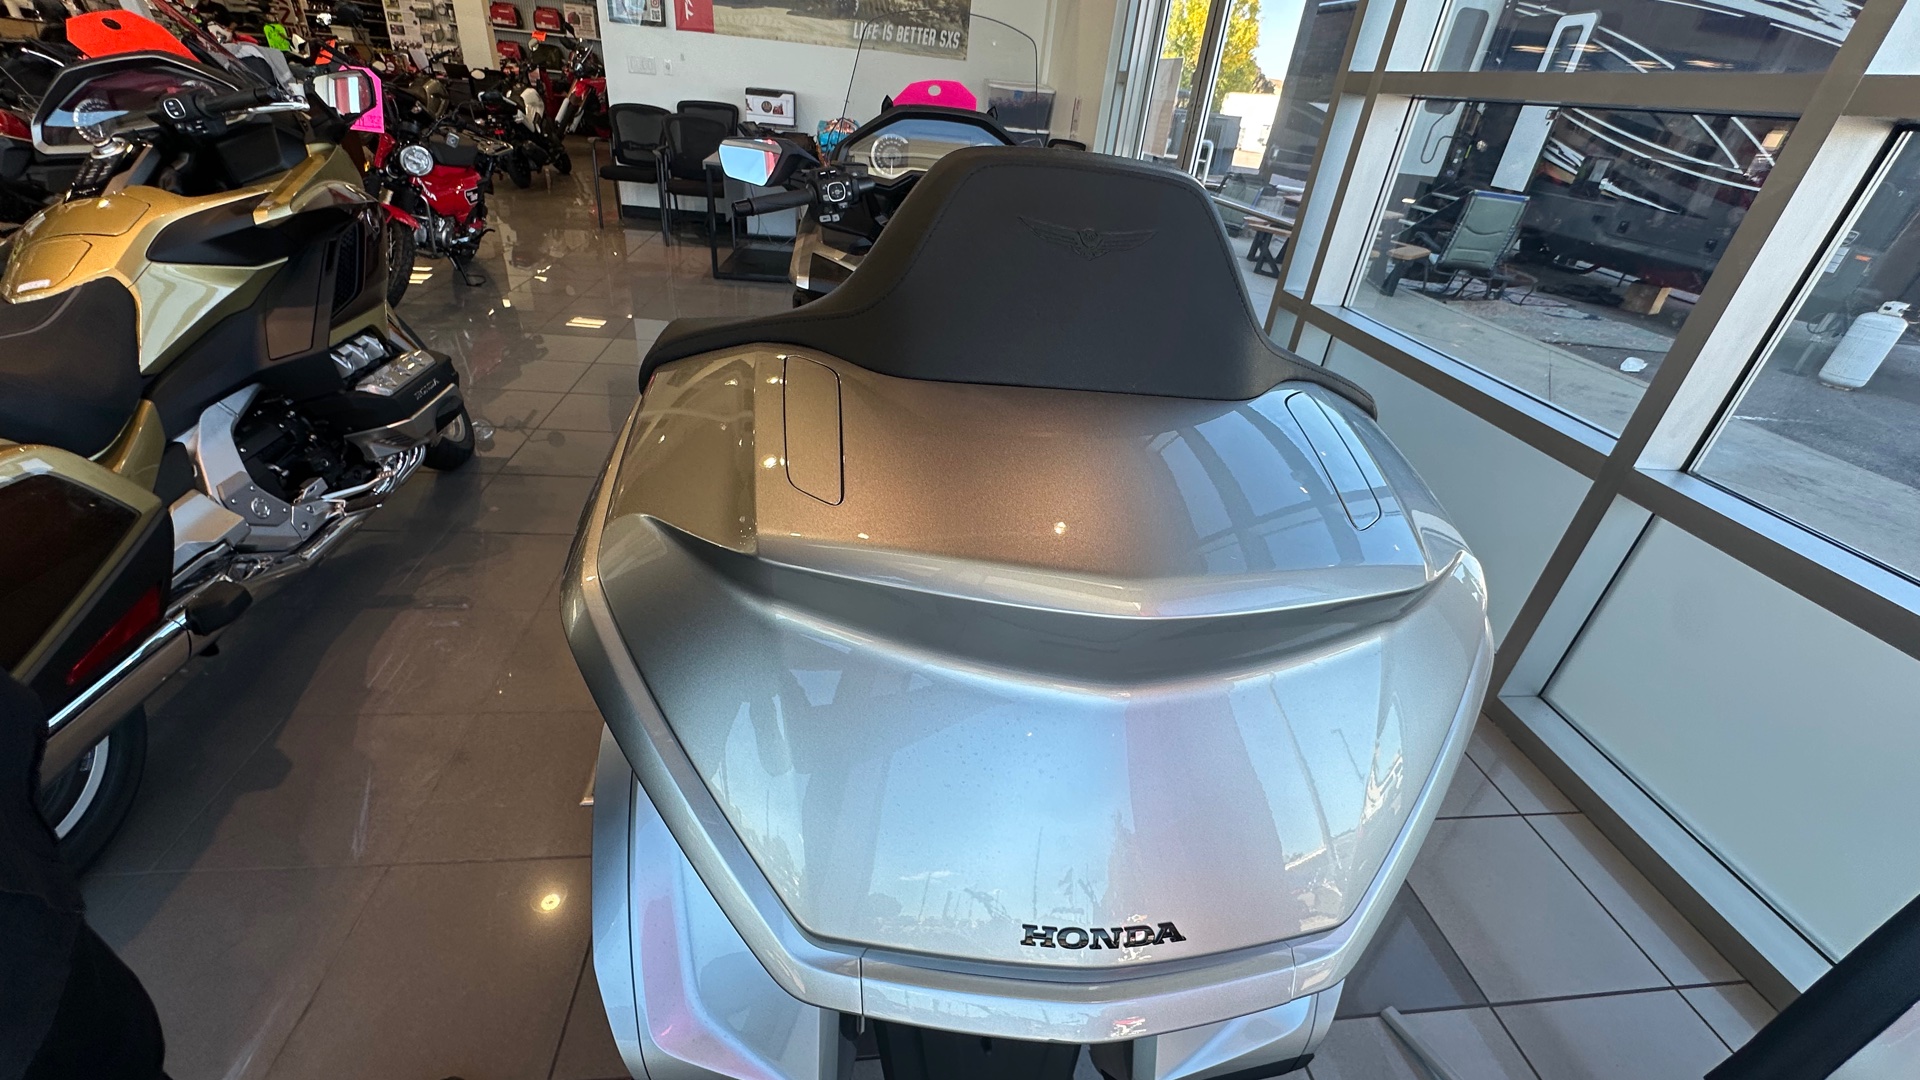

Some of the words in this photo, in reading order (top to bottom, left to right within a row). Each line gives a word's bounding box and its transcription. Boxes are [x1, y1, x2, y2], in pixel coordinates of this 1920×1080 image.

[853, 21, 880, 39] LIFE
[882, 24, 894, 41] IS
[896, 25, 936, 46] BETTER
[939, 30, 961, 49] SXS
[1020, 921, 1187, 950] HONDA
